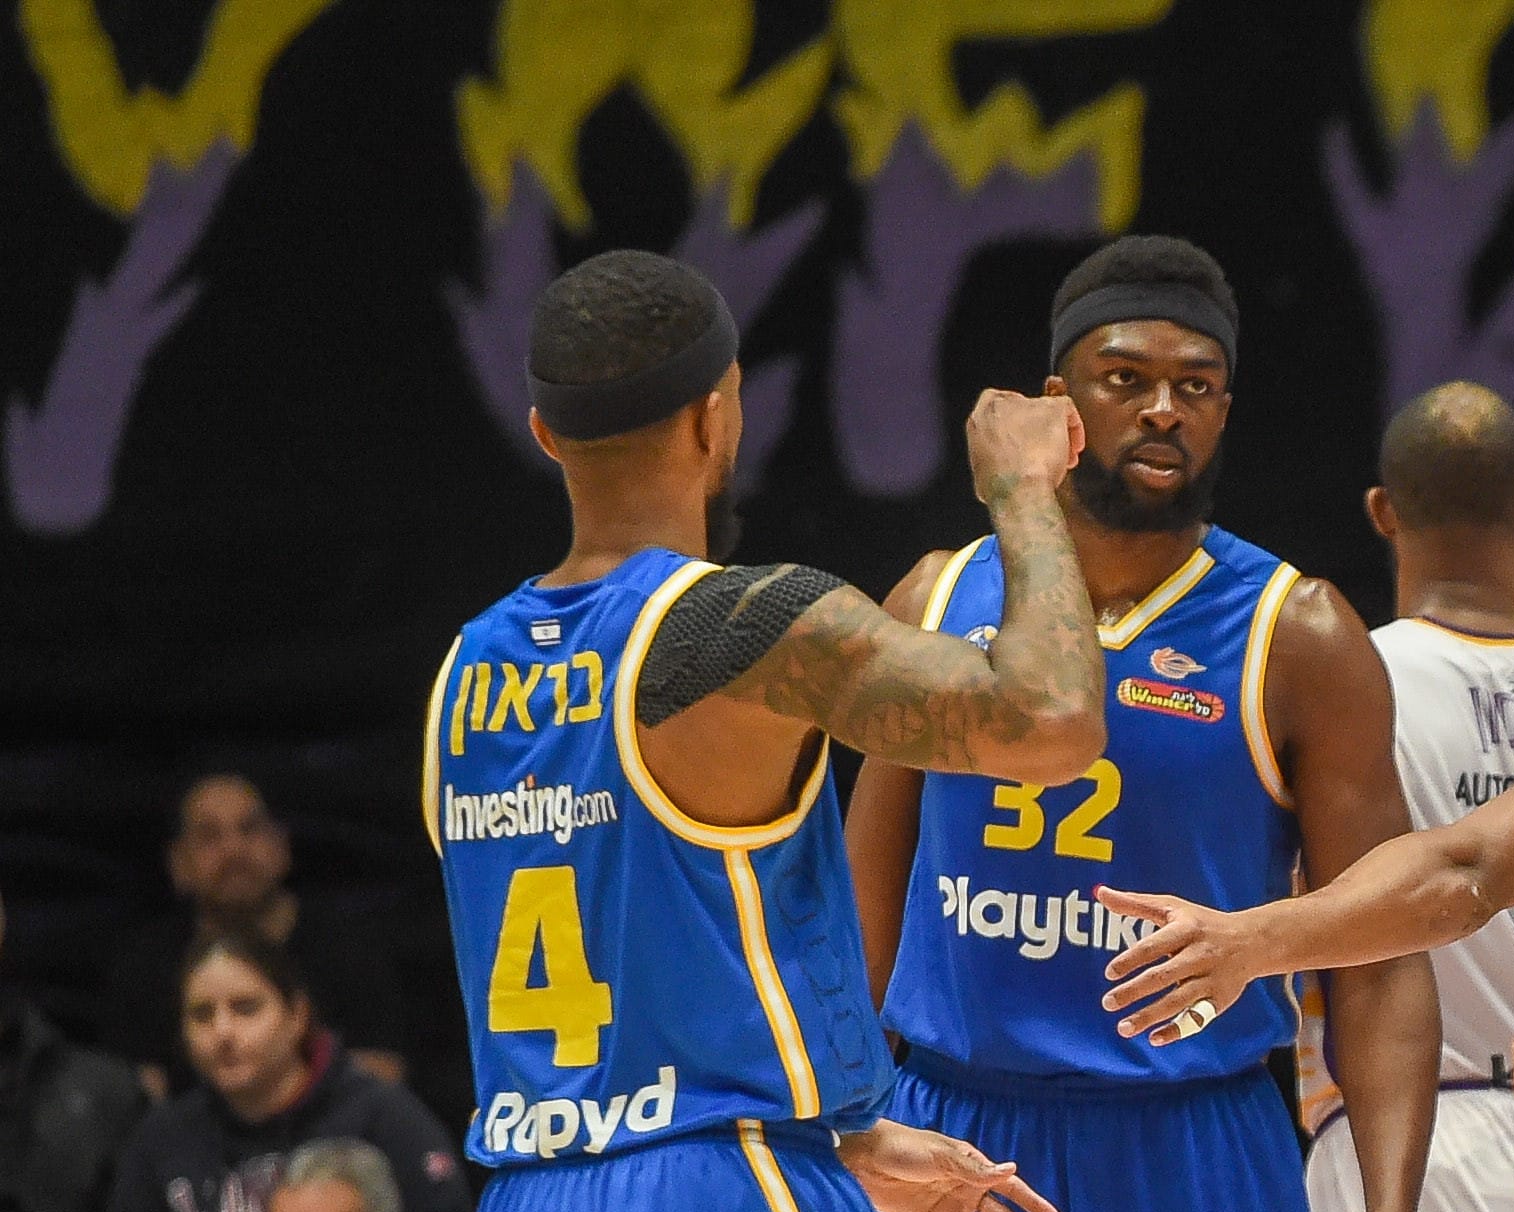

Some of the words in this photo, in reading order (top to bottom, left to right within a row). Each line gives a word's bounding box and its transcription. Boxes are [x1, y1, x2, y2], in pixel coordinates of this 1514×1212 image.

[1130, 685, 1194, 711] Winner
[445, 774, 618, 844] Investing.com
[983, 758, 1122, 862] 32
[488, 865, 612, 1067] 4
[484, 1066, 676, 1159] Rapyd
